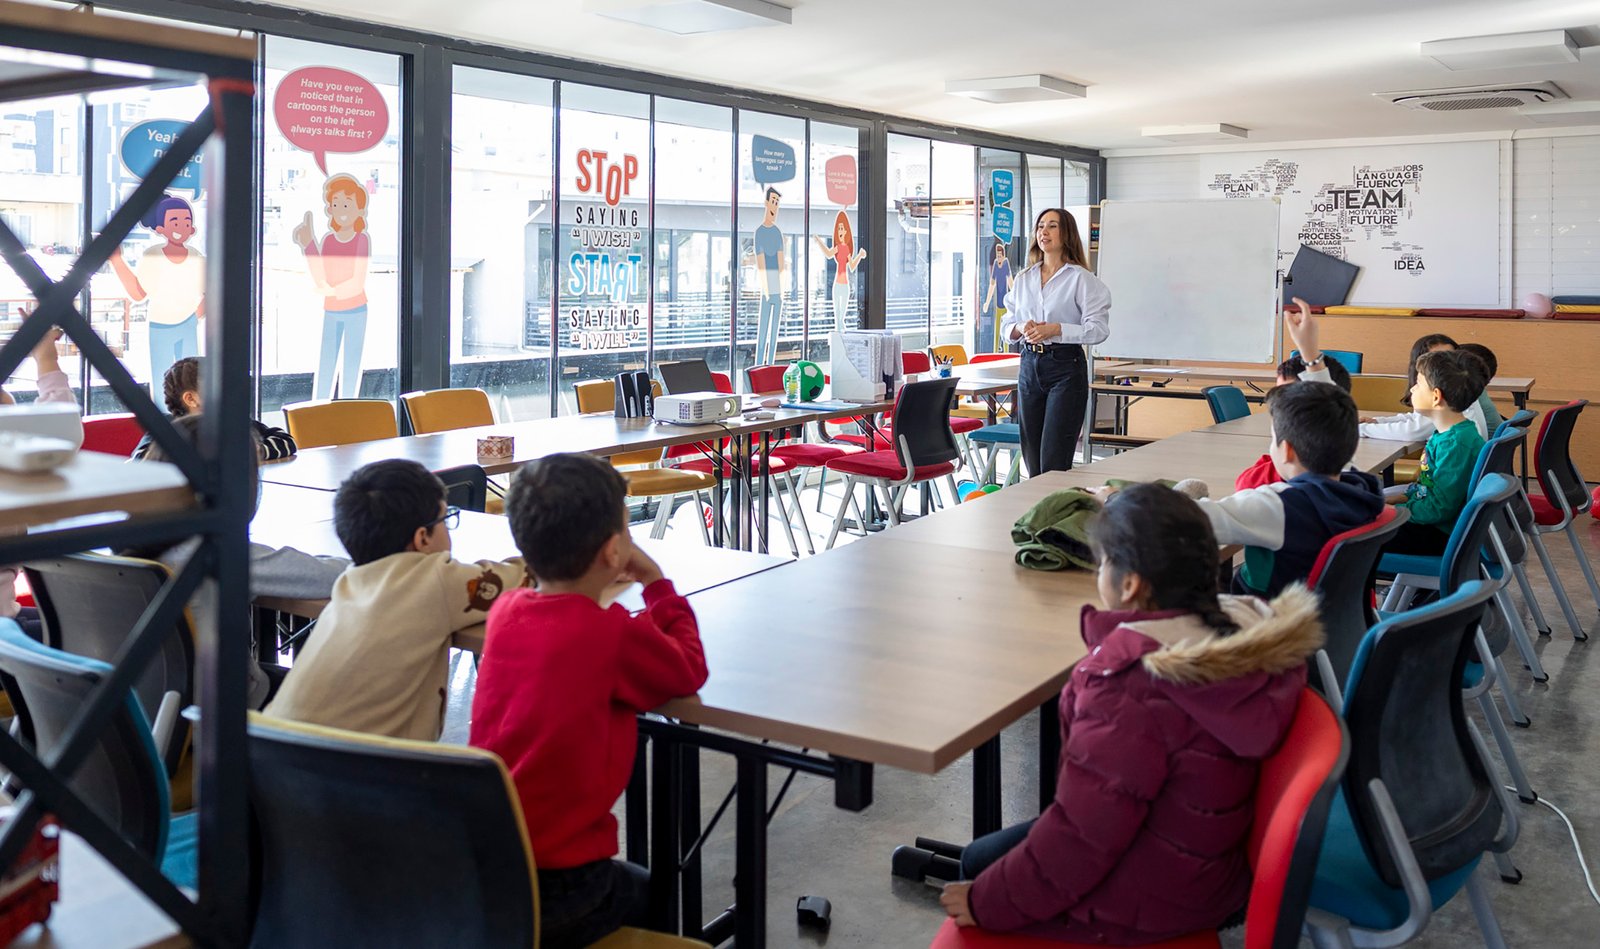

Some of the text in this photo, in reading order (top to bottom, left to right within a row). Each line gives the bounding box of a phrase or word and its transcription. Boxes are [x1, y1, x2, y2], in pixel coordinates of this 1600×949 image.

[300, 78, 364, 93] Have you ever
[300, 91, 364, 104] noticed that in
[287, 101, 376, 117] cartoons the person
[324, 115, 338, 125] the
[340, 117, 355, 126] left
[290, 124, 373, 139] always talks first ?
[755, 156, 776, 165] languages
[576, 149, 638, 206] STOP
[1356, 172, 1419, 180] LANGUAGE
[1223, 183, 1254, 193] PLAN
[1356, 179, 1405, 188] FLUENCY
[1328, 188, 1404, 209] TEAM
[1313, 203, 1334, 213] JOB
[576, 206, 638, 227] SAYING
[1350, 215, 1398, 225] FUTURE
[1394, 260, 1425, 270] IDEA
[570, 253, 642, 302] START
[571, 309, 640, 327] SAYING
